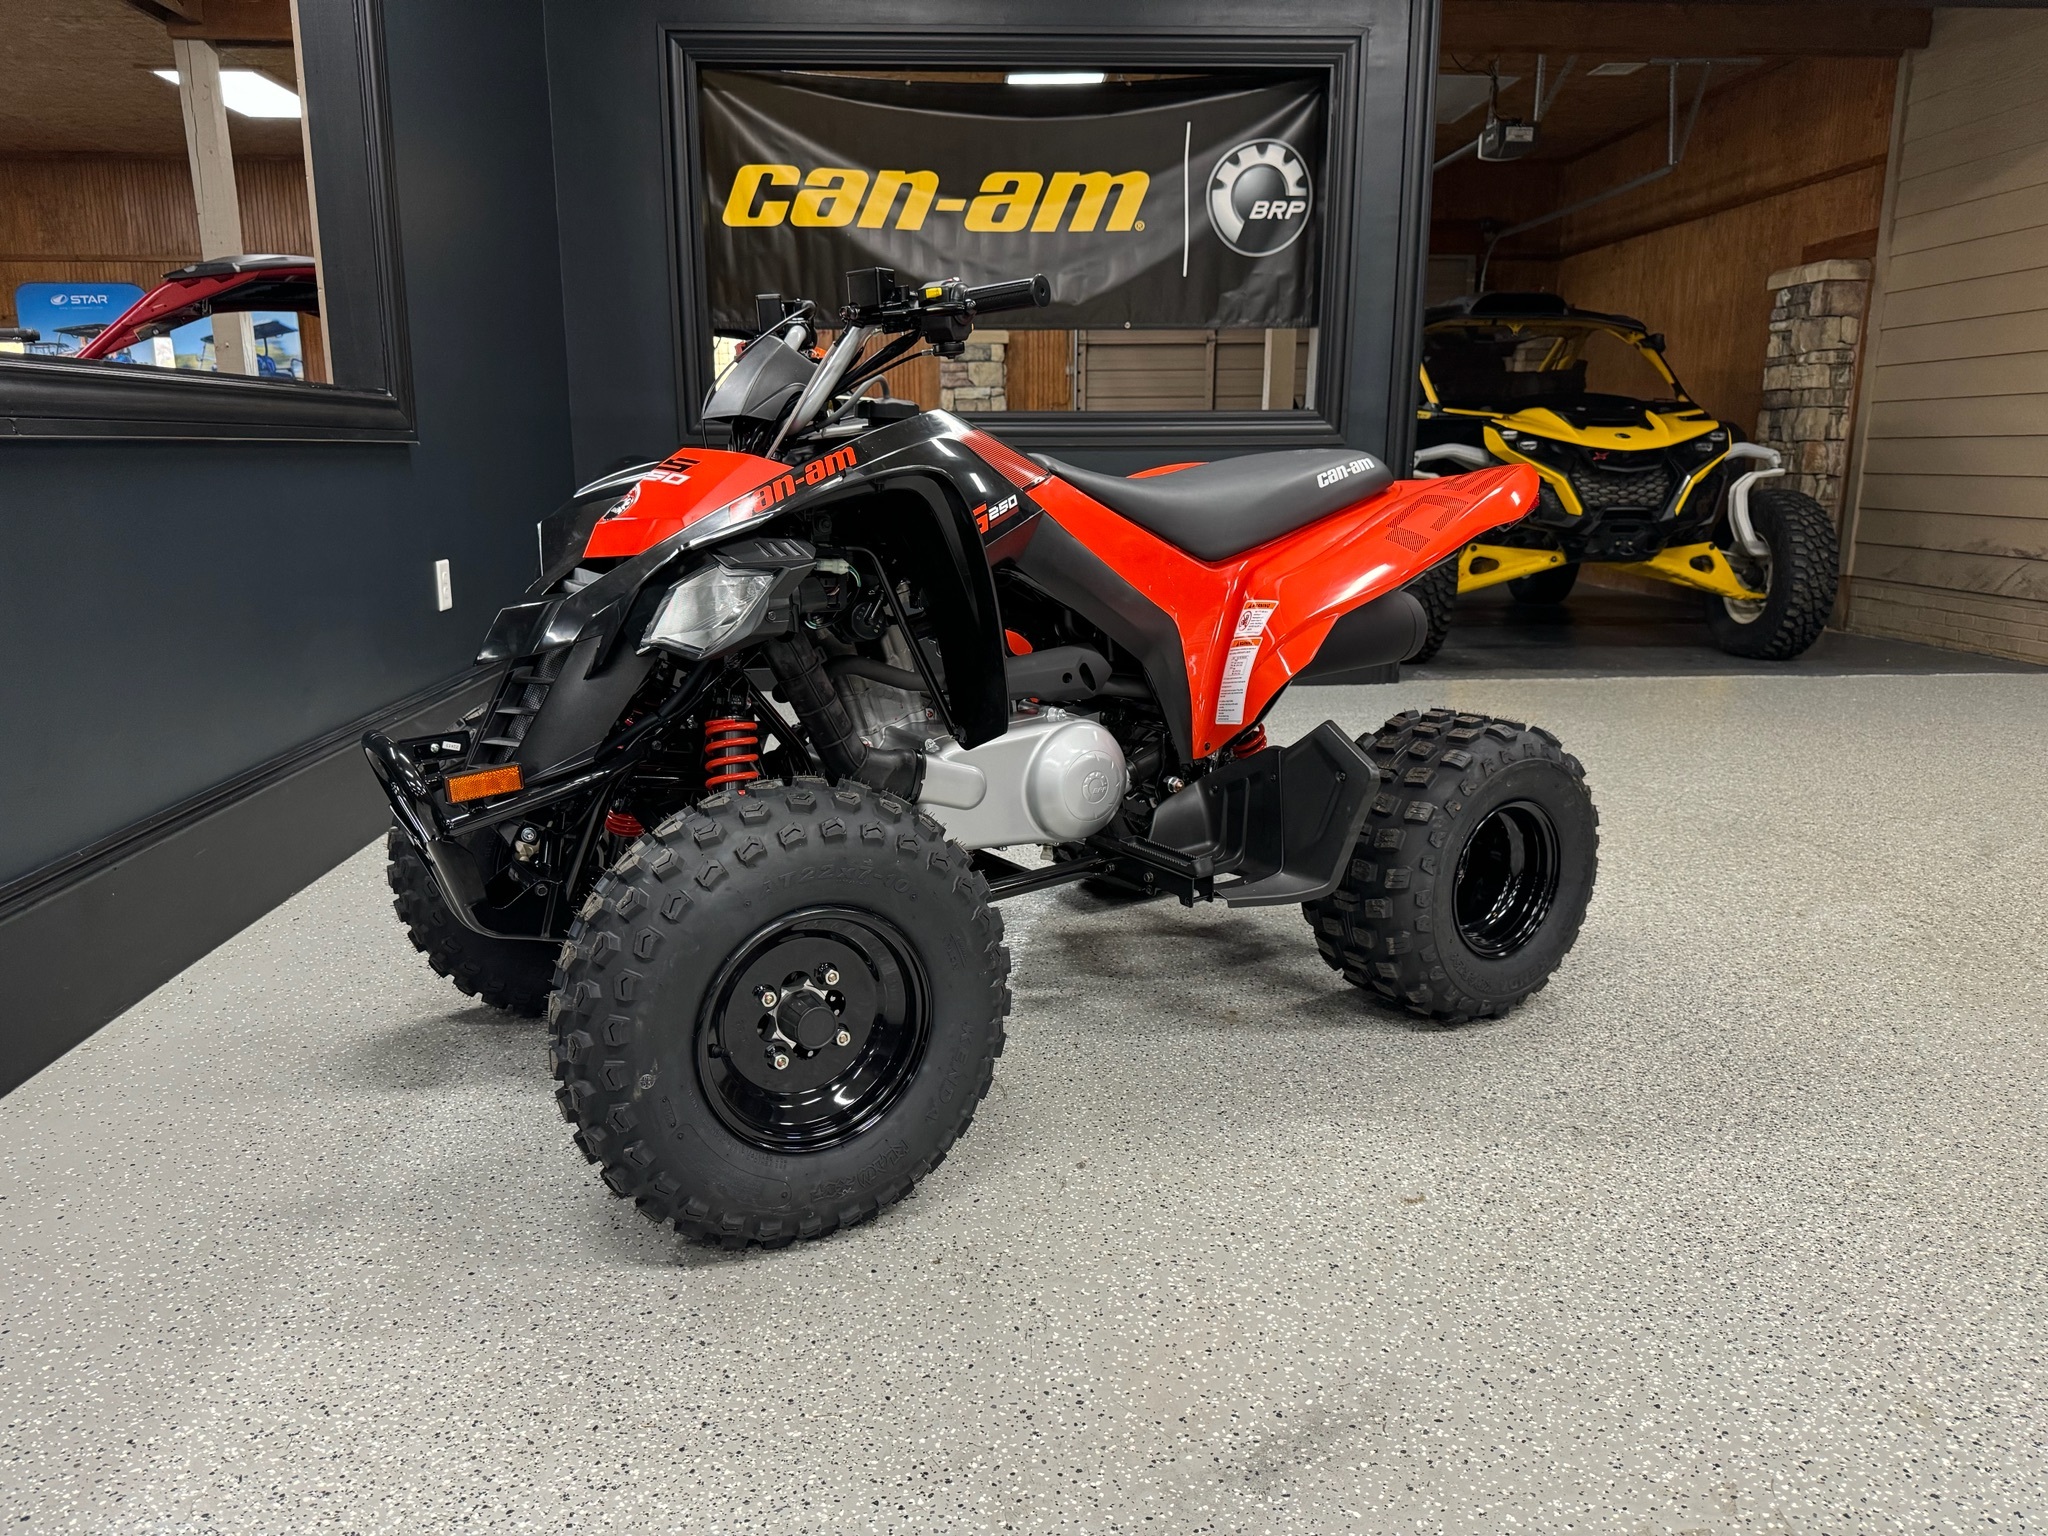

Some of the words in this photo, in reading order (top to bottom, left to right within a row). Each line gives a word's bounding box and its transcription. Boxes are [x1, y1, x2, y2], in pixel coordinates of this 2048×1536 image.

[722, 164, 1150, 232] can-am
[1249, 200, 1306, 220] BRP
[70, 294, 108, 304] STAR
[655, 457, 700, 473] S
[1316, 457, 1375, 488] can-am
[641, 469, 691, 486] 50
[730, 446, 857, 522] an-am
[988, 494, 1018, 521] 250
